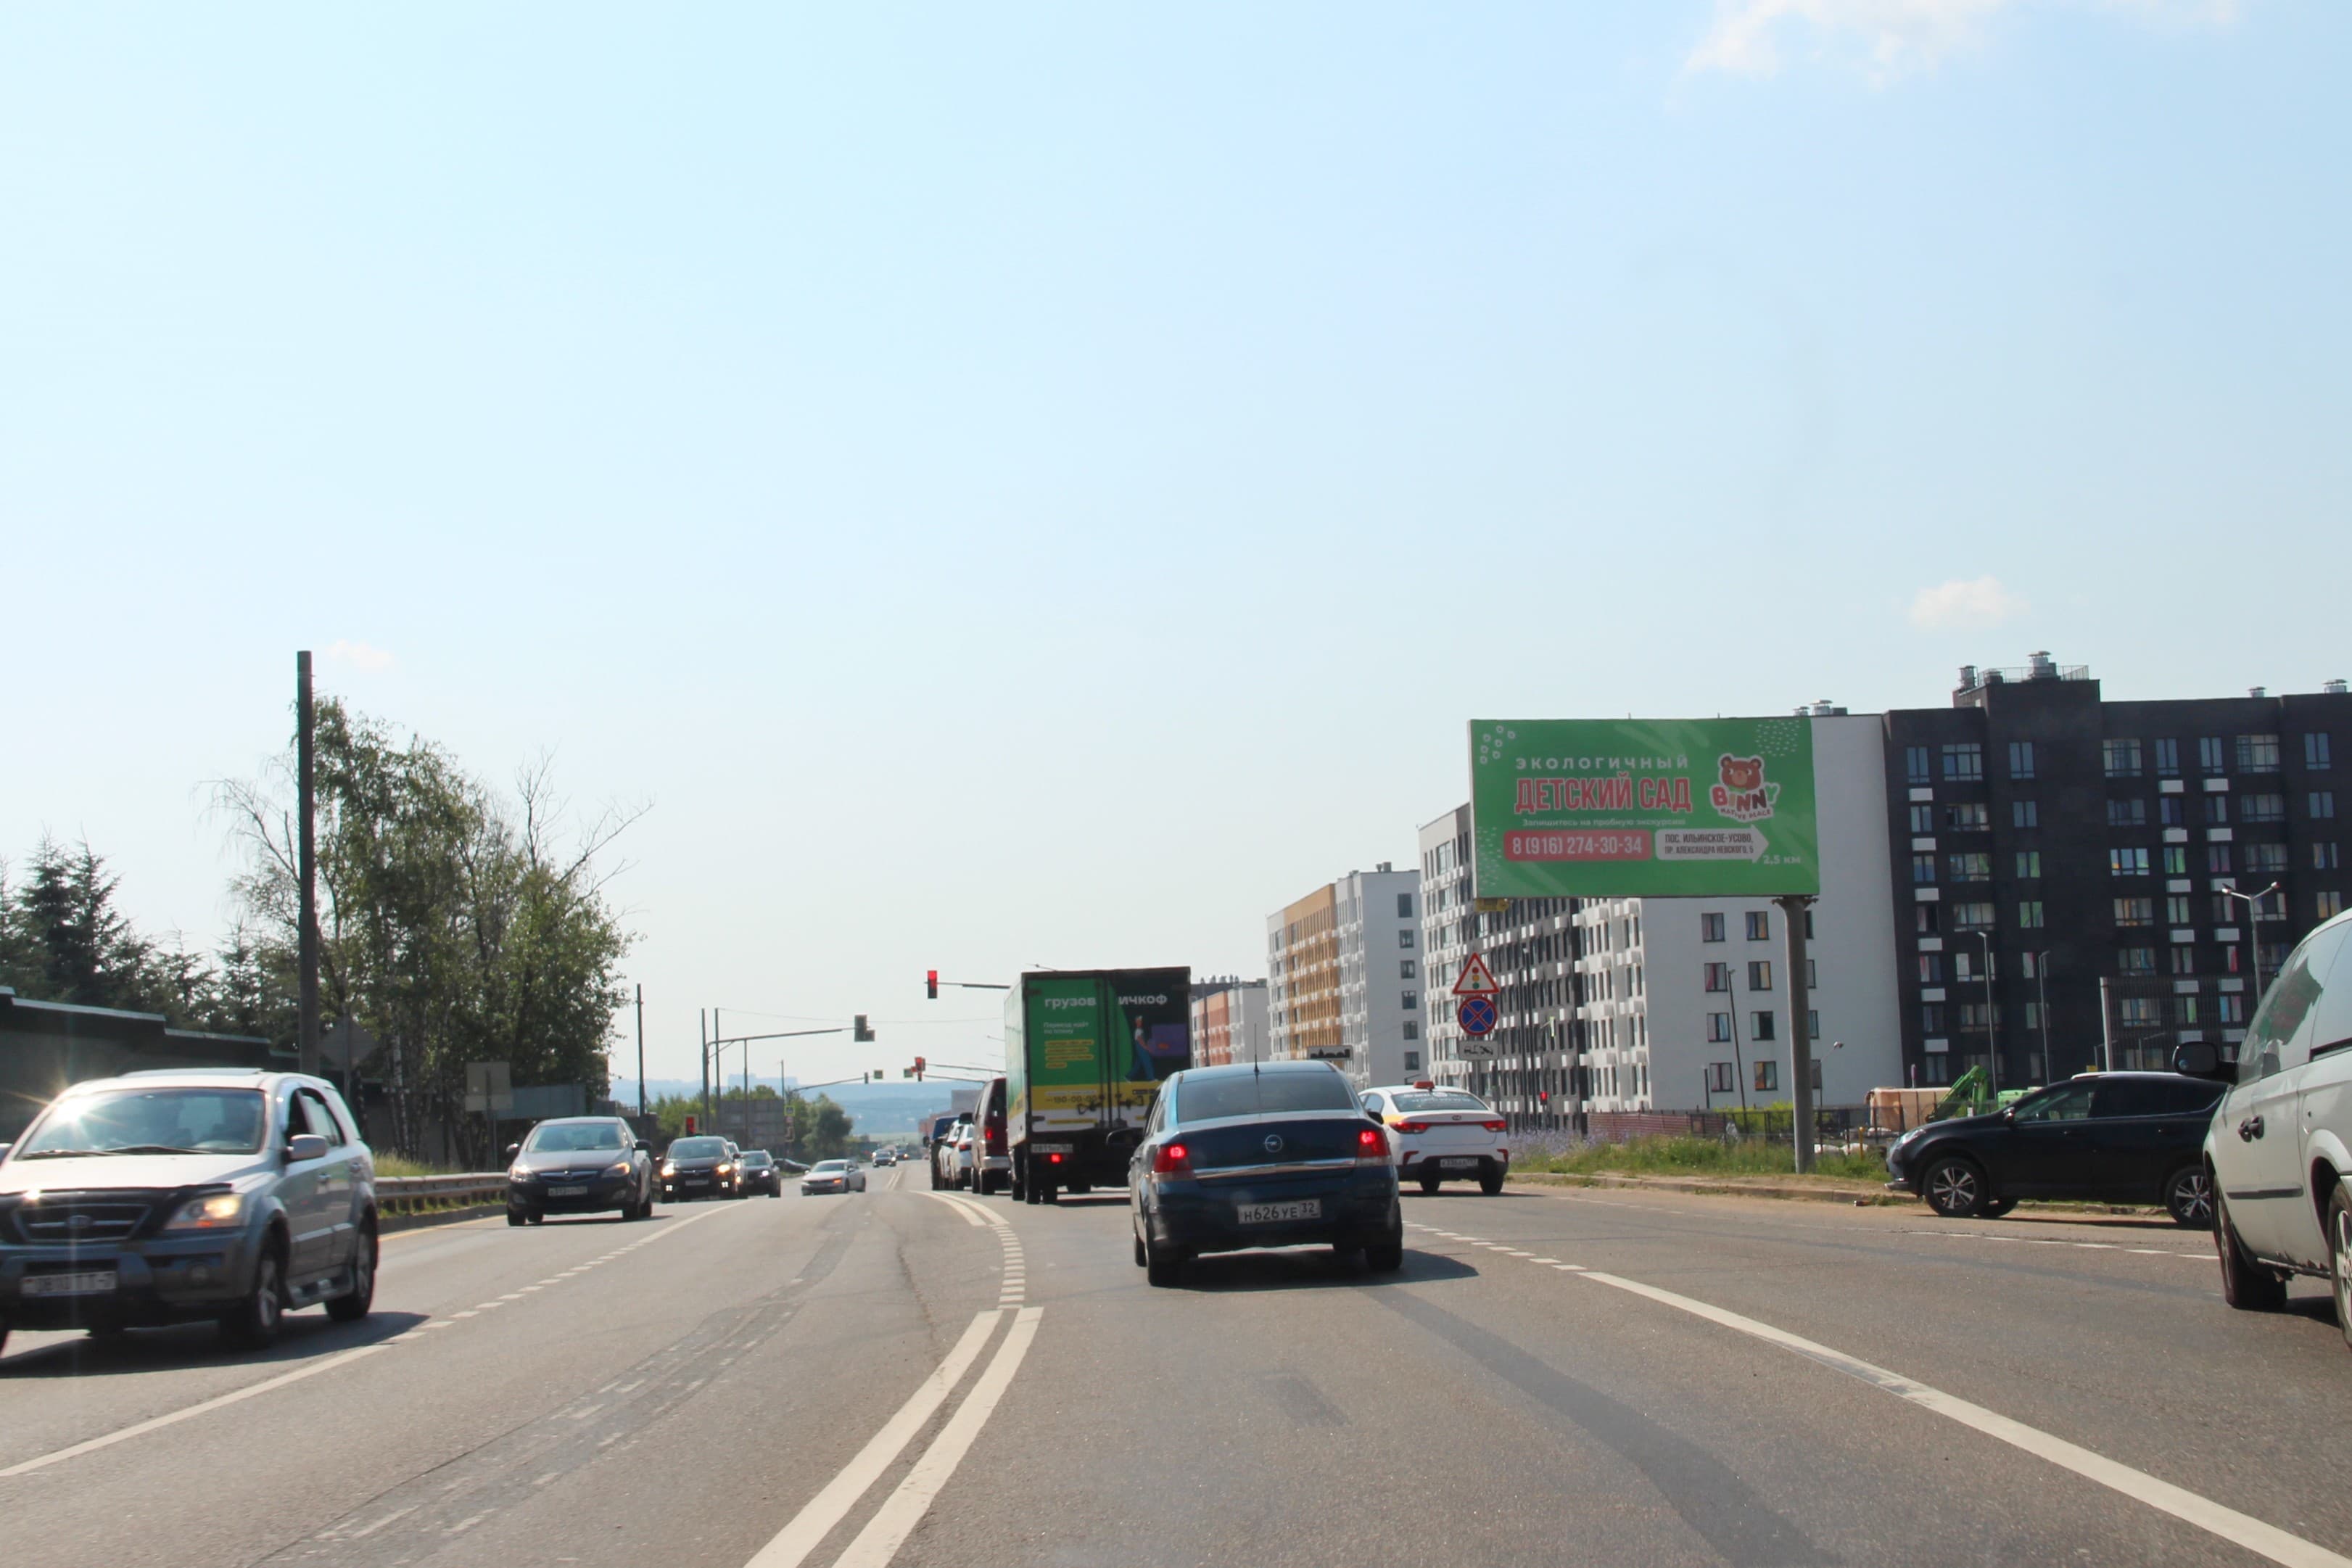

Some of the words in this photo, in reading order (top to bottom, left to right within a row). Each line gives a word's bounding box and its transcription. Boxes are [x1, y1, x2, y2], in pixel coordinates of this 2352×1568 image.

[1515, 754, 1689, 770] ЭКОЛОГИЧНЫЙ
[1514, 771, 1632, 814] ДЕТСКИЙ
[1639, 777, 1693, 813] САД
[1522, 818, 1578, 827] Запишитесь
[1593, 818, 1634, 827] пробную
[1512, 837, 1522, 854] 8
[1525, 836, 1563, 854] (916)
[1567, 836, 1643, 854] 274-30-34
[1665, 833, 1680, 843] ПОС.
[1763, 854, 1780, 865] 2,5
[1044, 997, 1097, 1010] грузов
[1118, 994, 1168, 1005] ичкоф
[1243, 1205, 1297, 1222] Н626УЕ
[1301, 1202, 1315, 1213] 32
